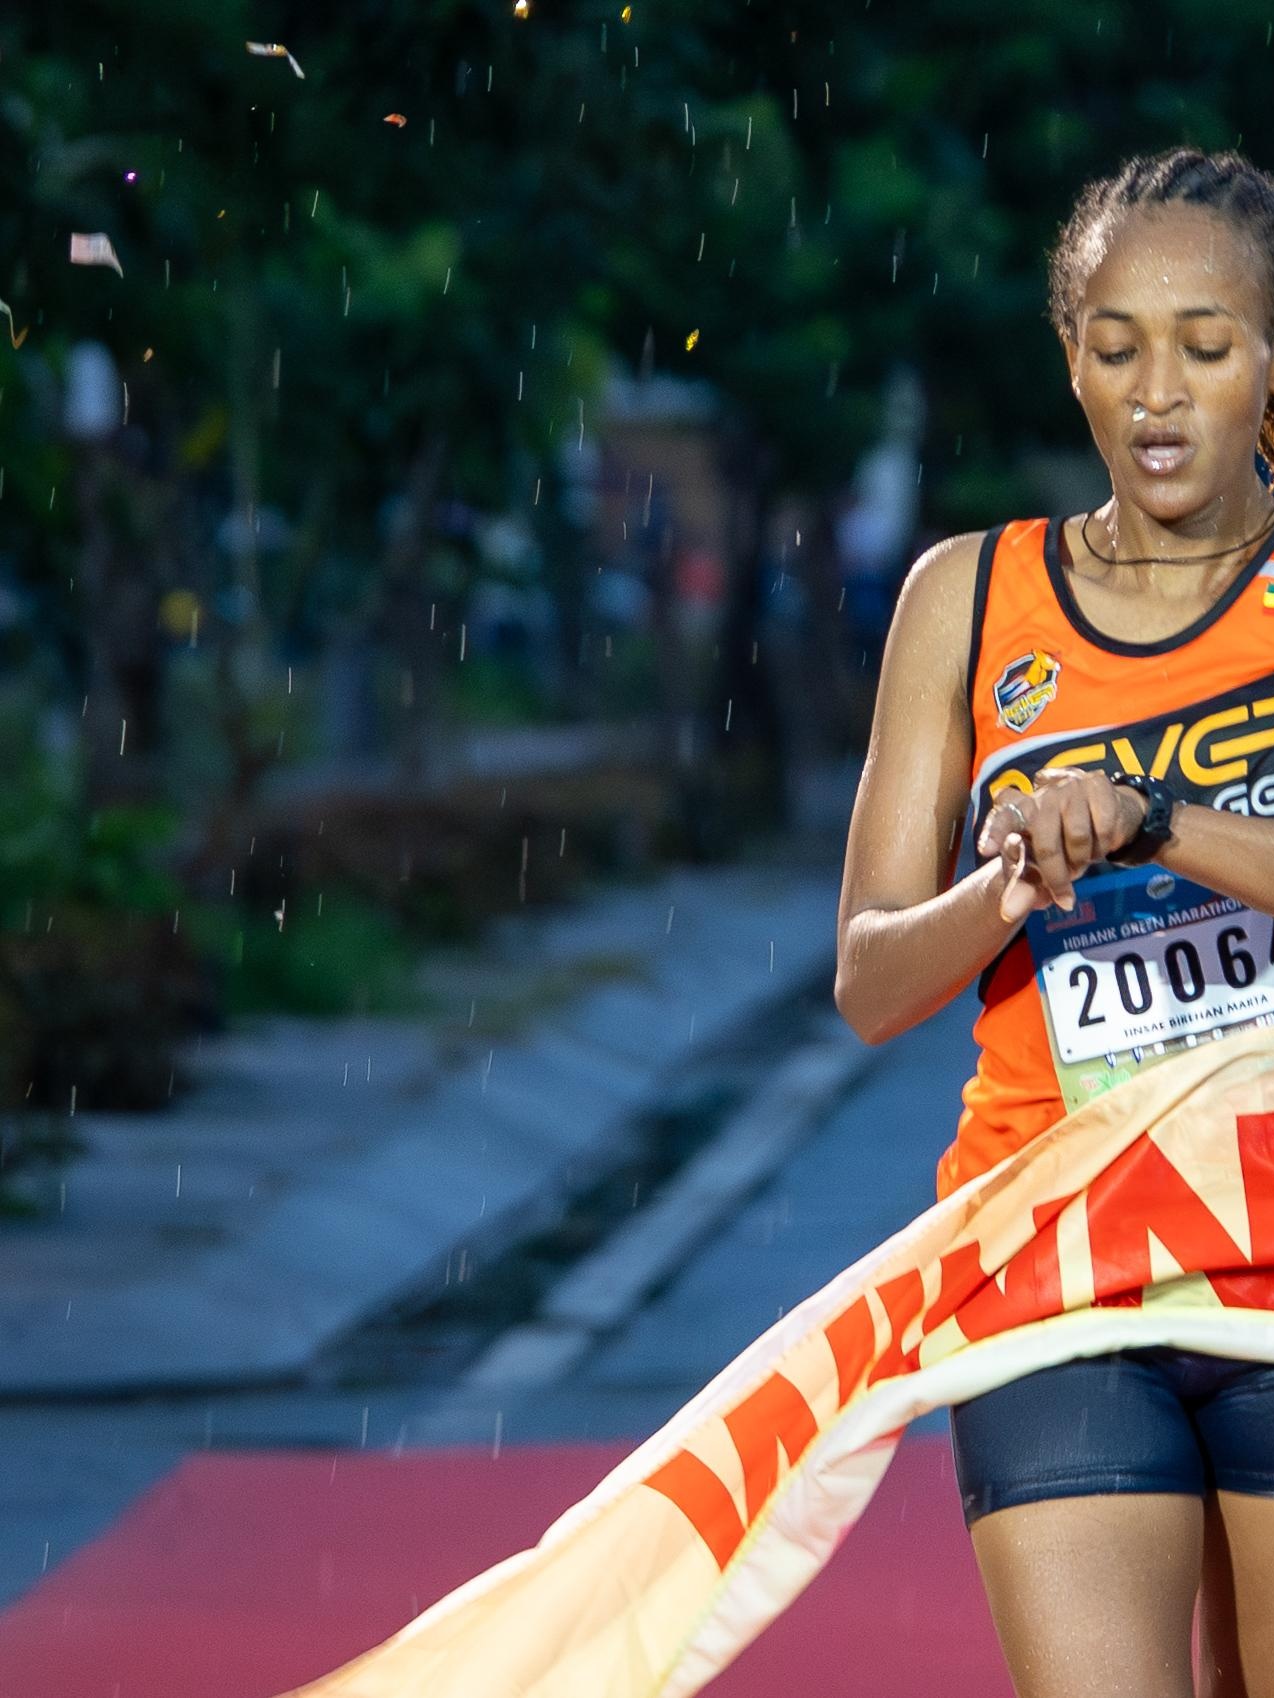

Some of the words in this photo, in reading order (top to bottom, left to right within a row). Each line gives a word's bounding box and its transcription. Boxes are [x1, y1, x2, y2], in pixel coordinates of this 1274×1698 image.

[1062, 927, 1118, 951] HDBANK
[1120, 915, 1166, 942] GREEN
[1227, 994, 1270, 1013] MARTA
